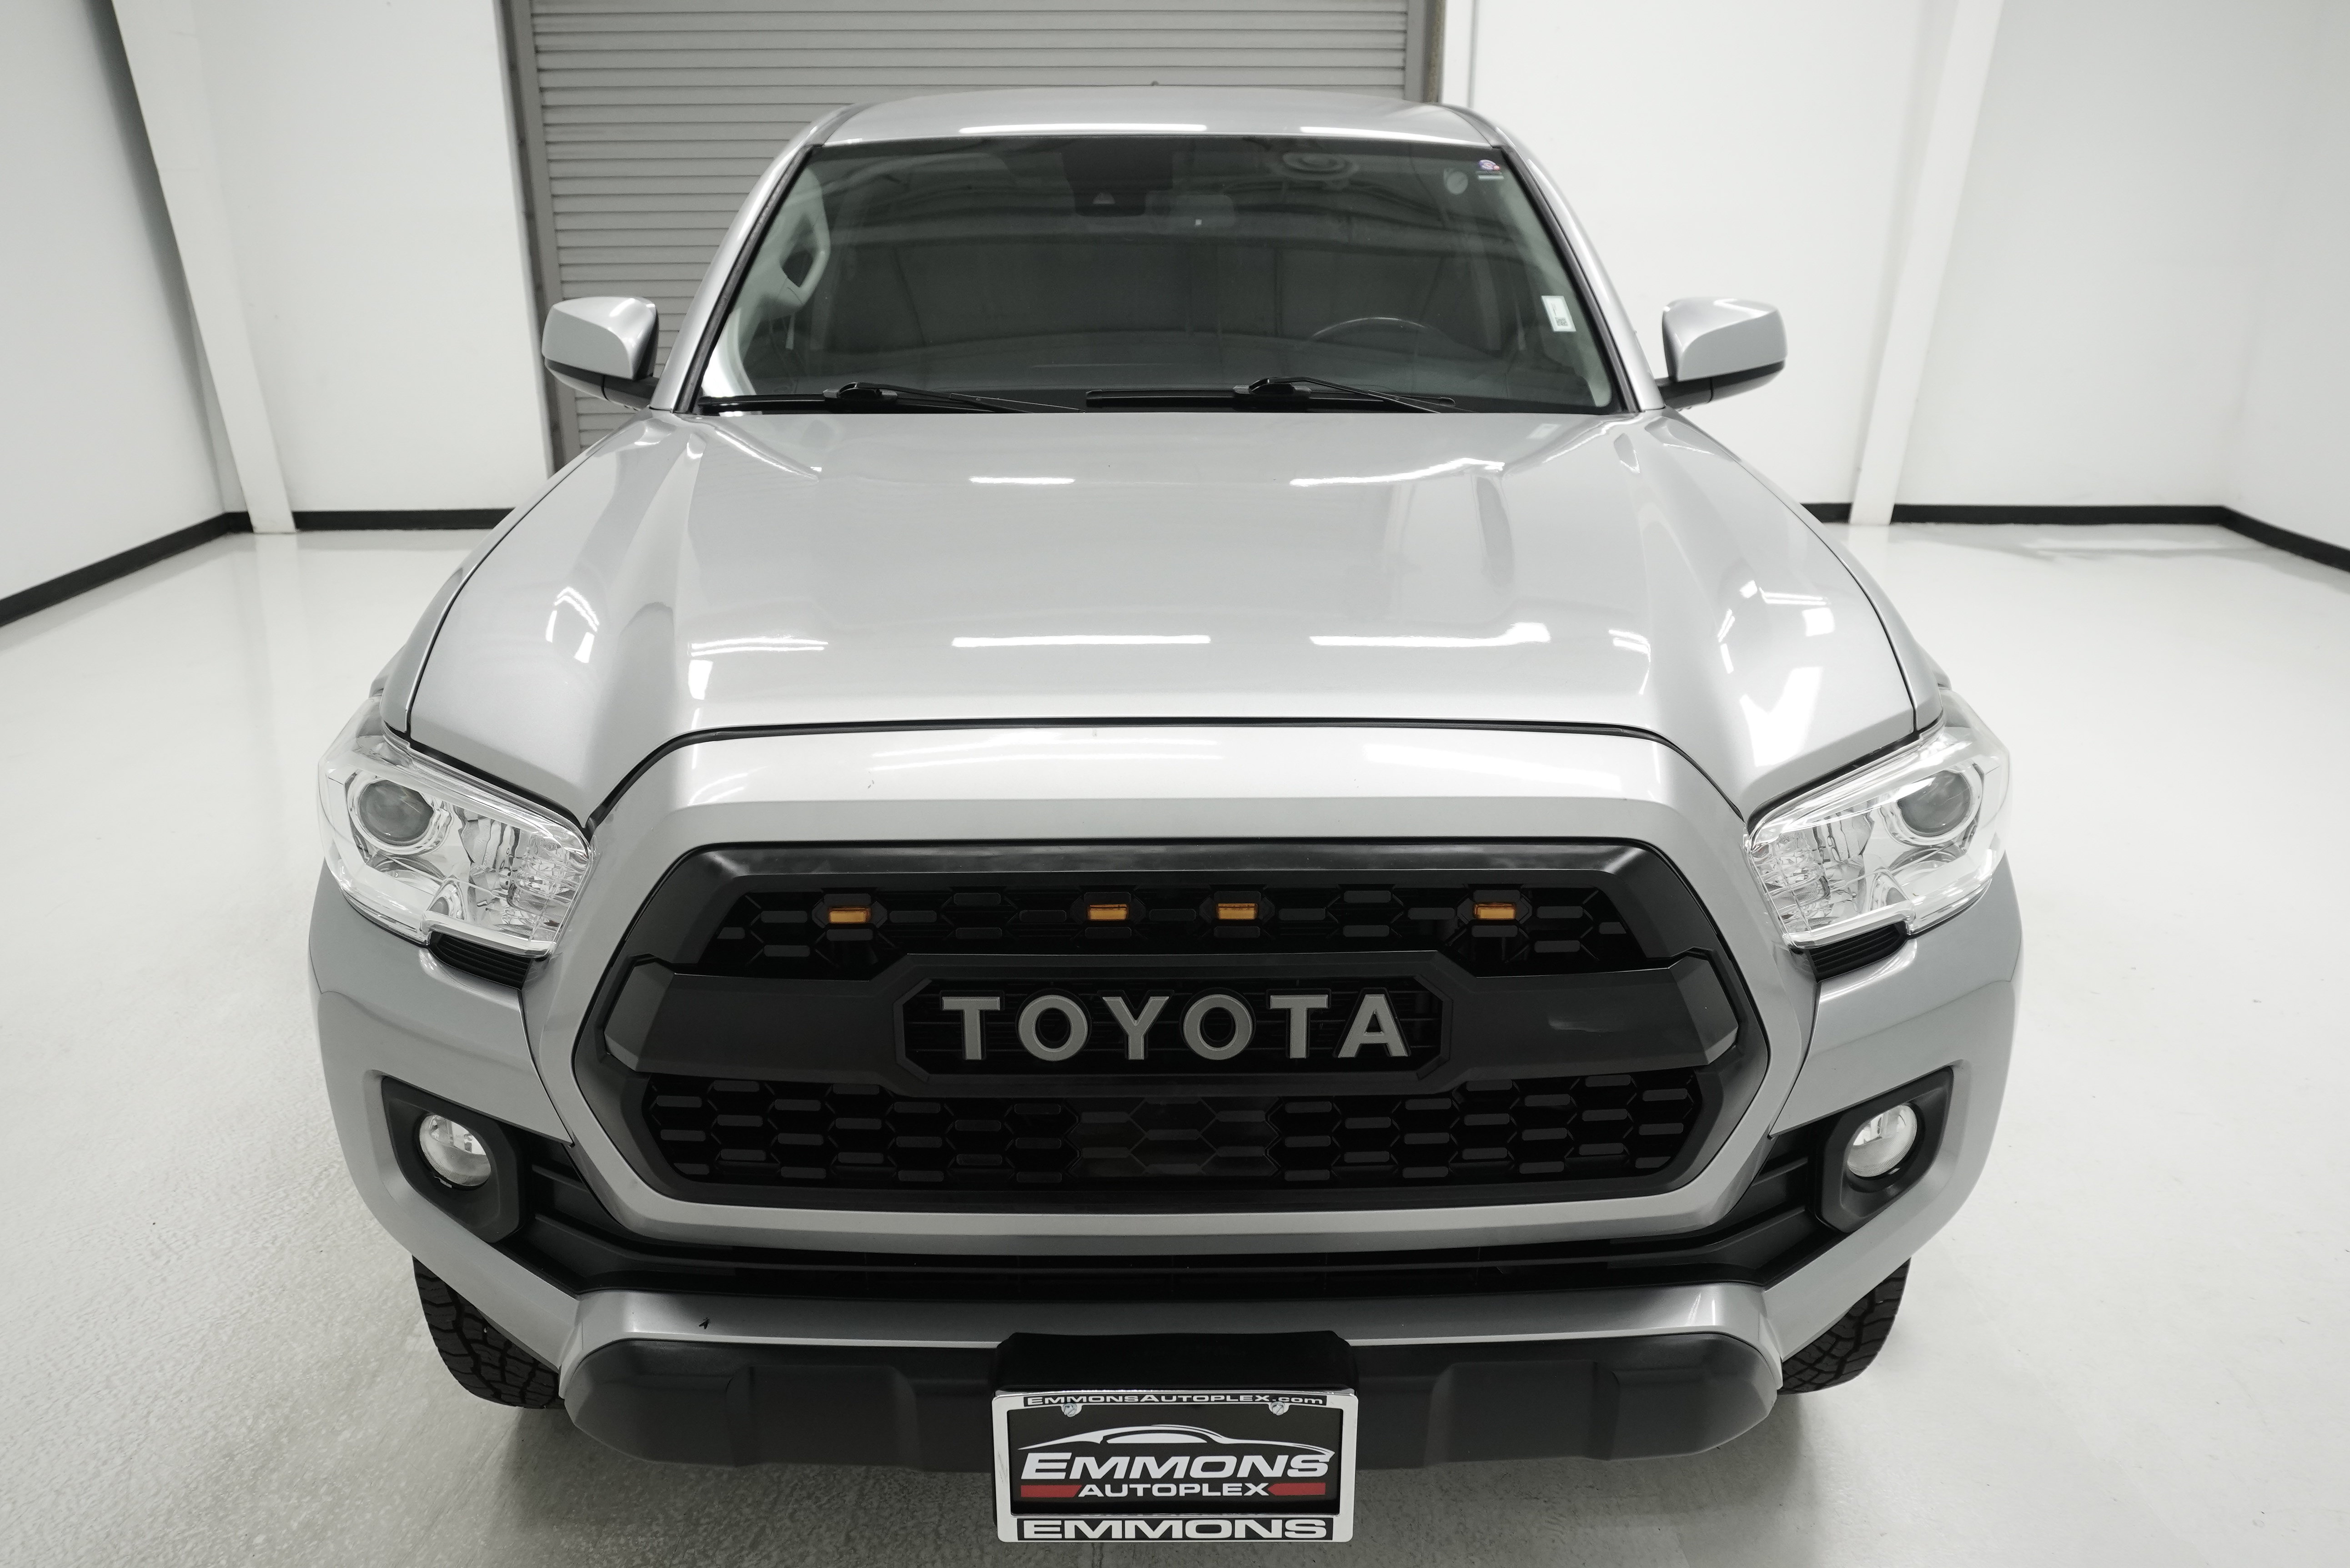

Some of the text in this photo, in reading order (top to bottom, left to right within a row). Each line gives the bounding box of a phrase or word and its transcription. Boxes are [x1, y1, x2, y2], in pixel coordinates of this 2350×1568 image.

[941, 993, 1409, 1062] TOYOTA
[1021, 1452, 1331, 1480] EMMONS
[1078, 1483, 1269, 1497] AUTOPLEX
[1023, 1519, 1327, 1539] EMMONS
